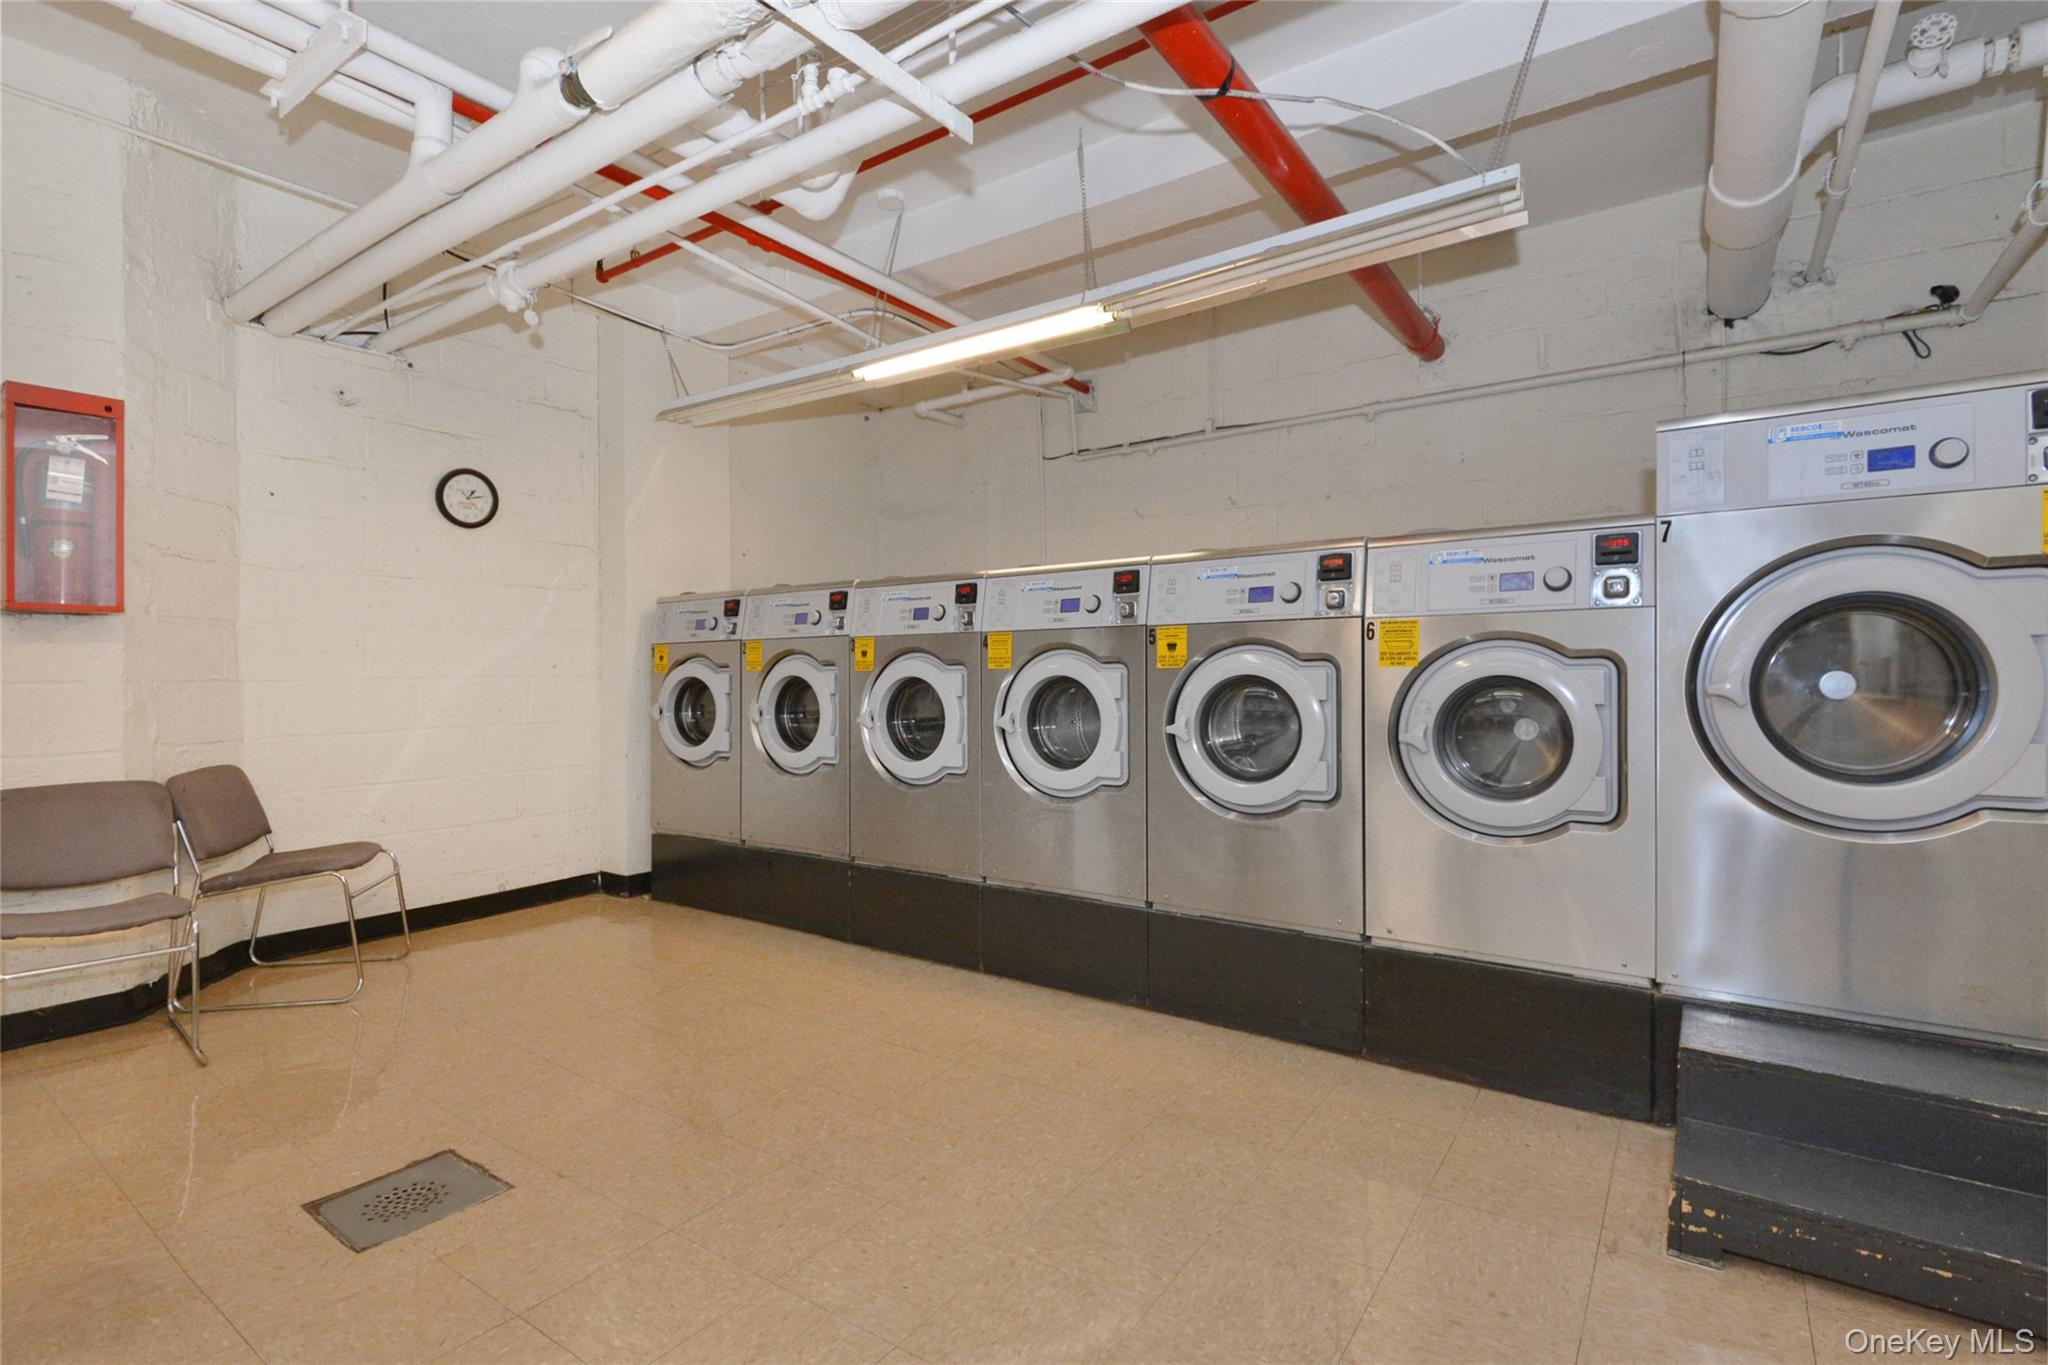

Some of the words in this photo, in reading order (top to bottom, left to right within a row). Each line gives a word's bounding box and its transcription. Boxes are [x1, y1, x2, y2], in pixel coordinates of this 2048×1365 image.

[1843, 424, 1918, 439] Wascomat
[1660, 520, 1673, 543] 7
[1483, 554, 1536, 564] Wascomat
[1148, 629, 1156, 646] 5
[1366, 621, 1375, 641] 6
